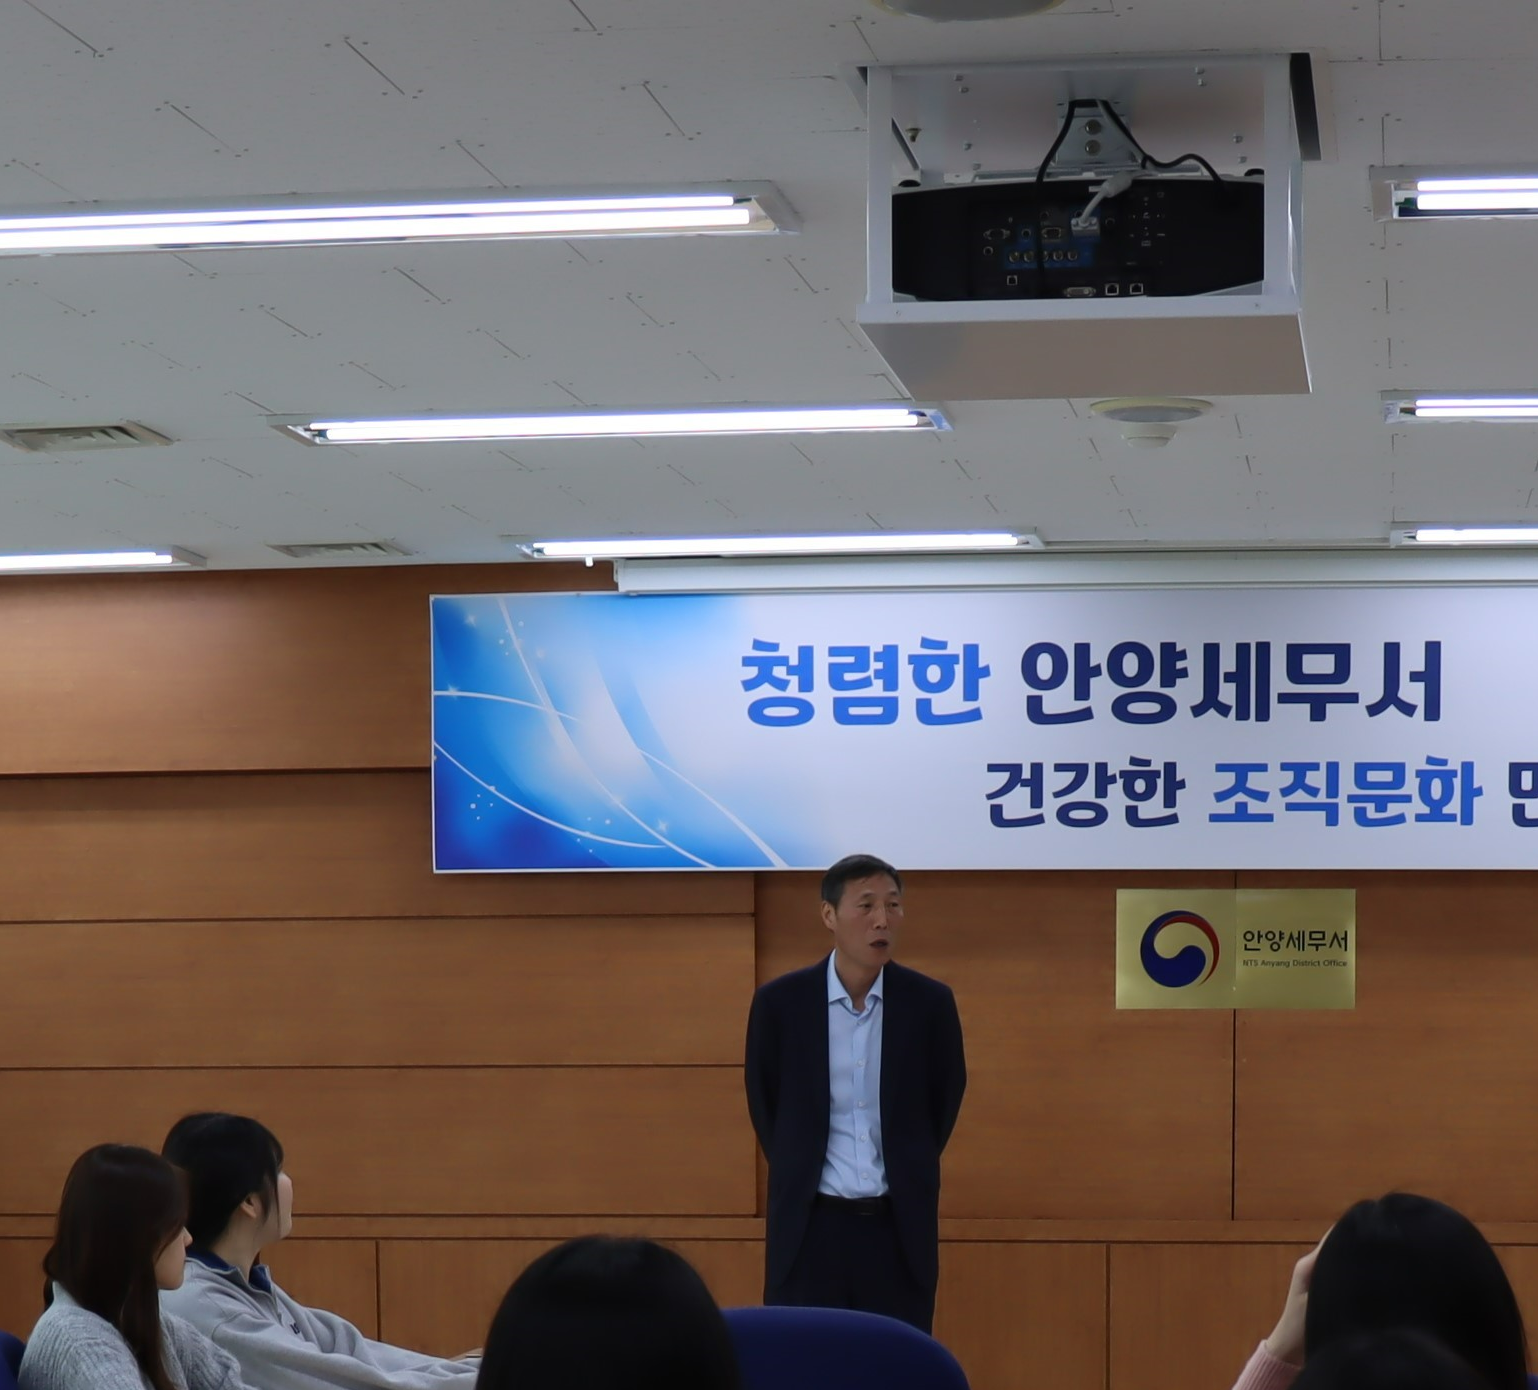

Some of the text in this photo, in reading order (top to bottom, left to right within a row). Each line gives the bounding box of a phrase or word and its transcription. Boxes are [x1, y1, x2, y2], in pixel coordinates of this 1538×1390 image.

[740, 636, 1442, 728] 청렴한 안양세무서
[985, 755, 1187, 829] 건강한
[1208, 755, 1484, 828] 조직문화
[1243, 930, 1348, 952] 안양세무서
[1243, 959, 1348, 968] NTS Anyang District Office
